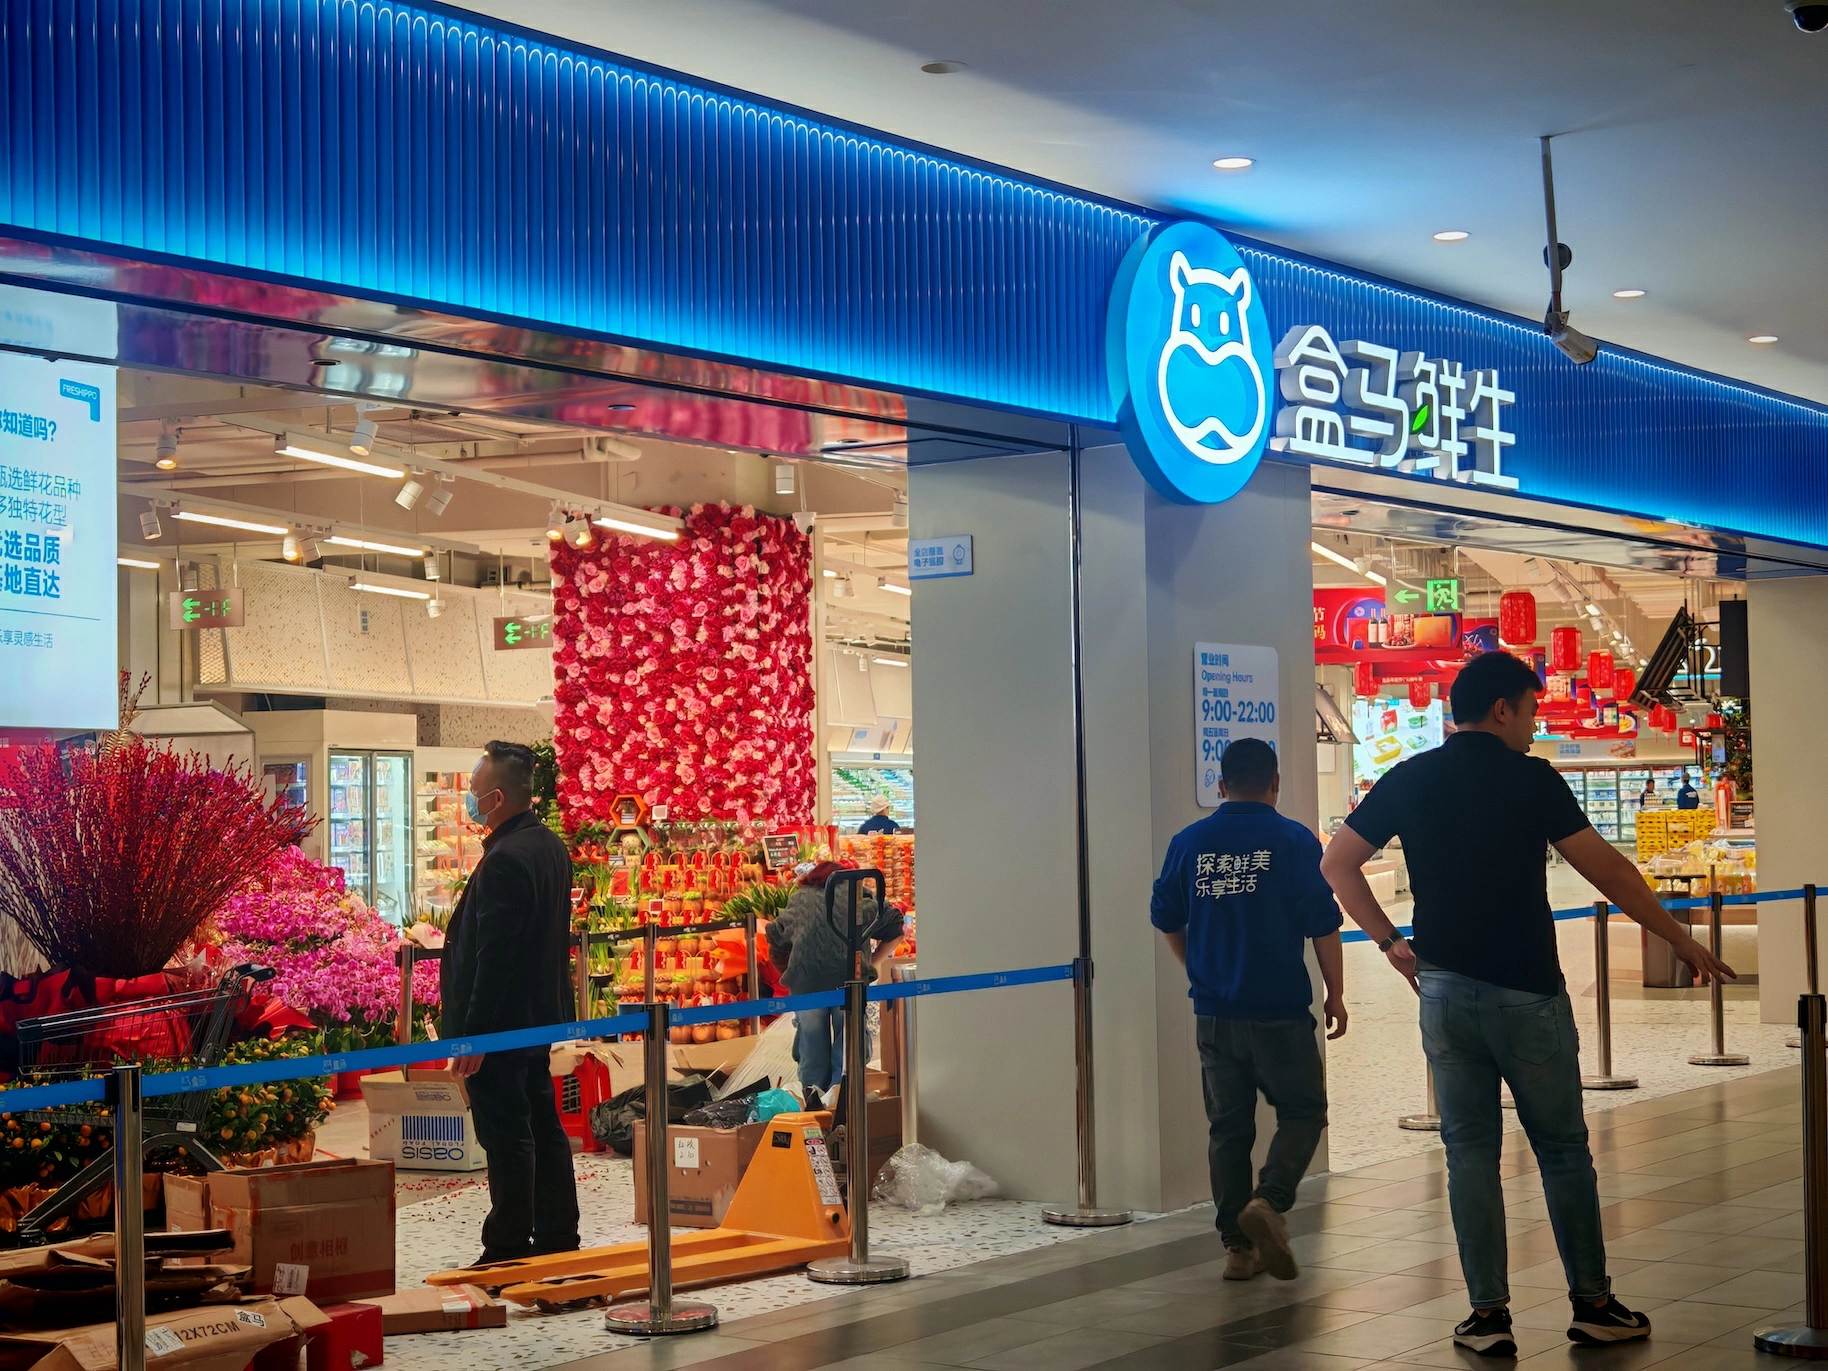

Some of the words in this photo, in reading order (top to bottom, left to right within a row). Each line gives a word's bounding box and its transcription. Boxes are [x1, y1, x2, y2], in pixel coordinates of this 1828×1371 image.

[1280, 325, 1519, 489] 盒马鲜生
[0, 409, 57, 442] 知道吗?
[0, 530, 60, 565] 选品质
[0, 563, 60, 598] 地直达
[1201, 669, 1231, 684] Opening
[1232, 671, 1253, 683] Hours
[1202, 699, 1275, 723] 9:00-22:00
[1196, 850, 1272, 876] 探索鲜美
[1195, 872, 1257, 899] 乐享生活
[237, 1310, 265, 1328] 盒马
